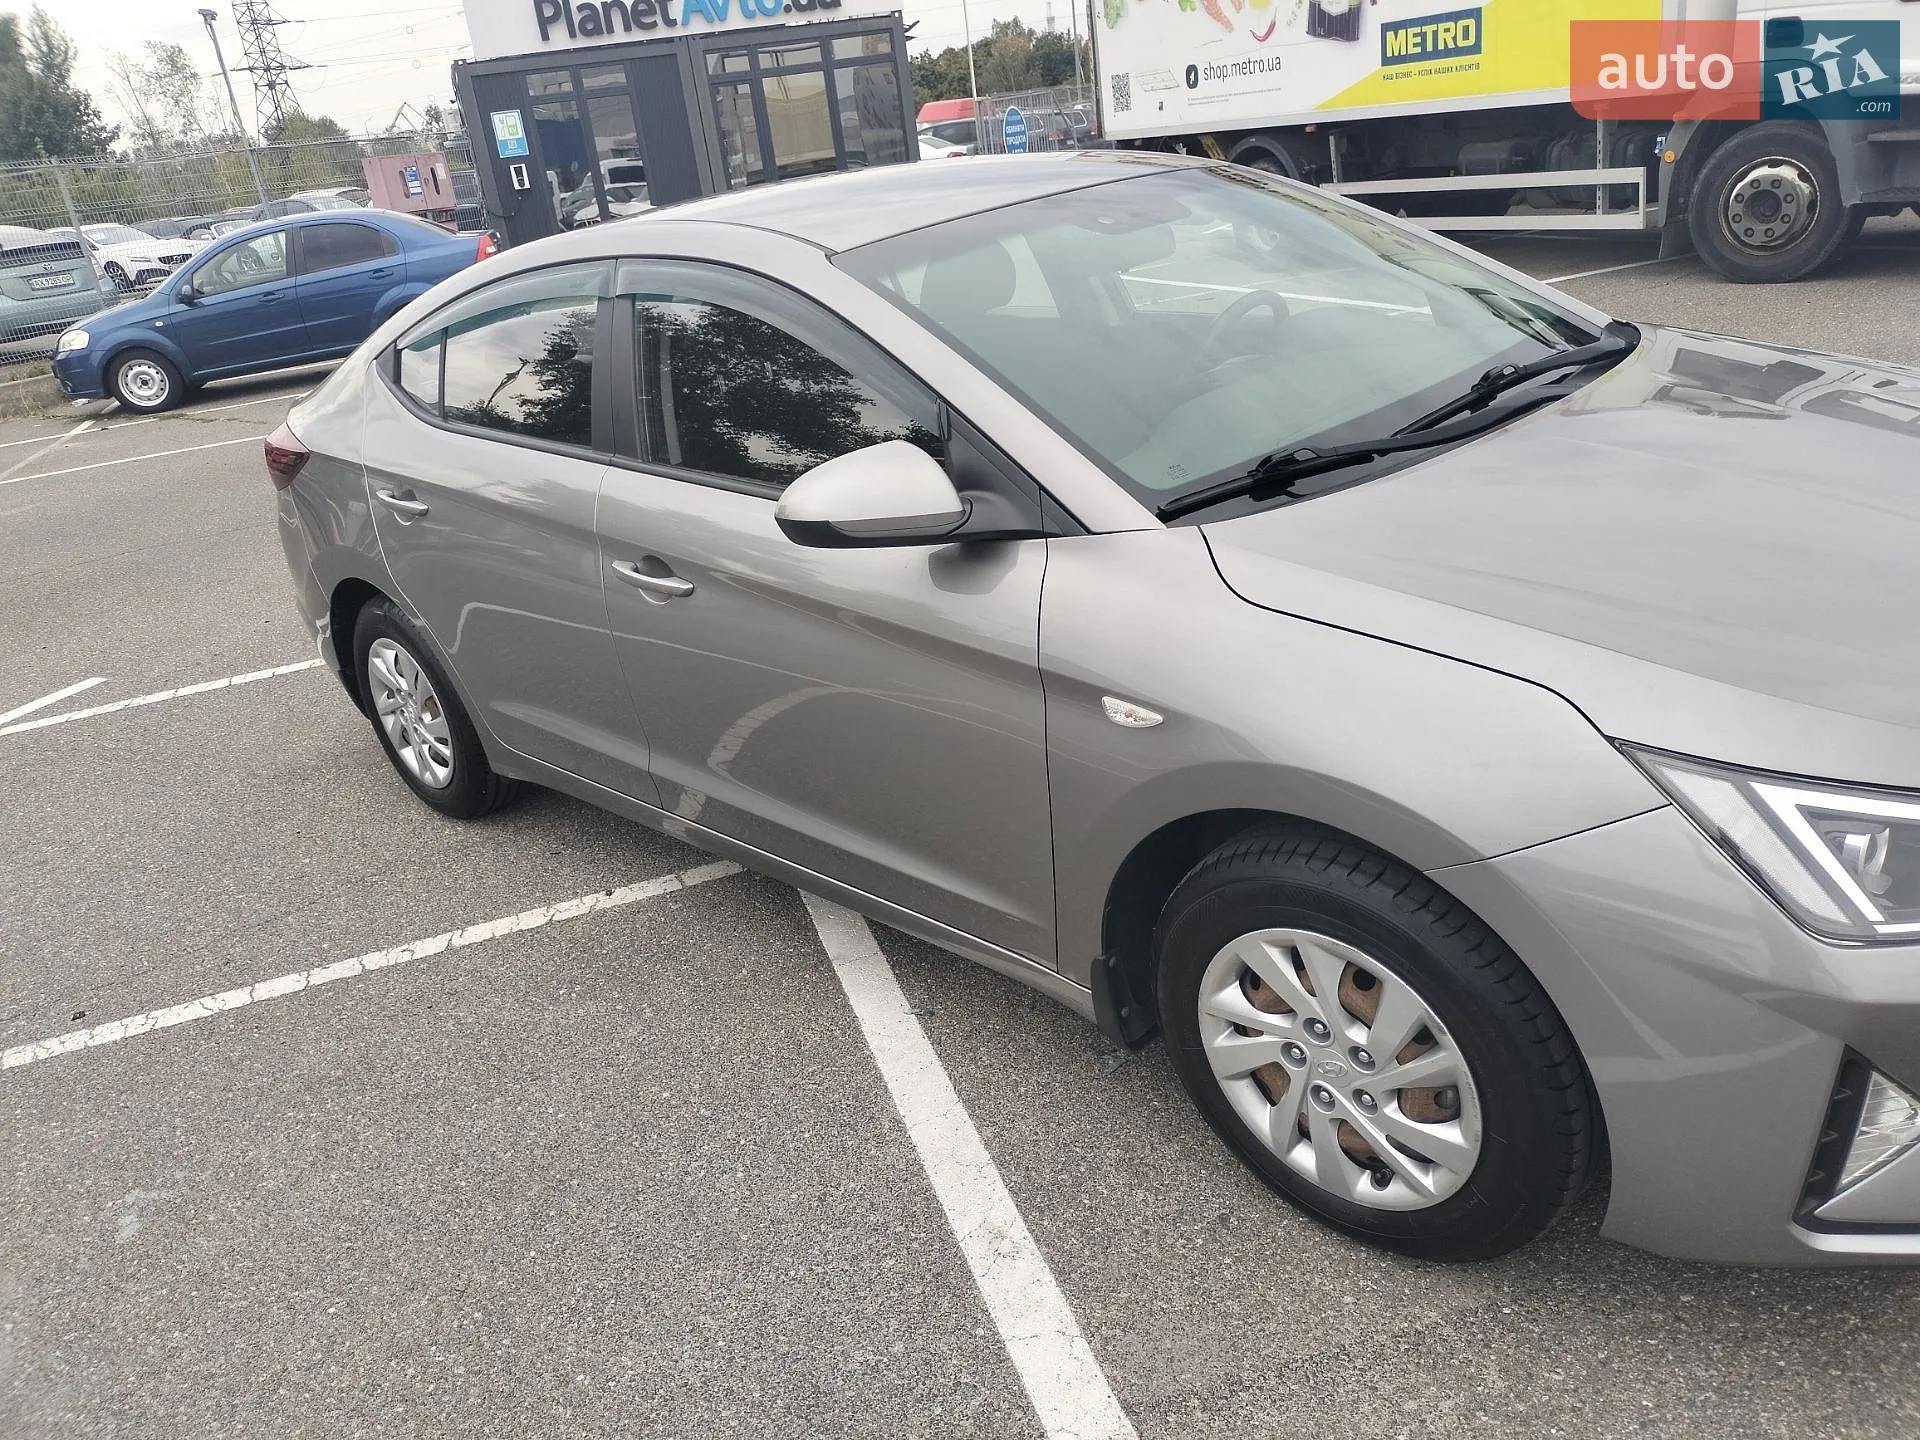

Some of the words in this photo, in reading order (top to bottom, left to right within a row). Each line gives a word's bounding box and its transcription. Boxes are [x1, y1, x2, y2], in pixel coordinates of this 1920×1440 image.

[534, 0, 842, 41] PlanetAvo.
[1386, 18, 1476, 57] METRO
[1203, 56, 1281, 83] shop.metro.ua
[1383, 73, 1394, 81] НАШ
[1395, 71, 1413, 80] БІЗНЕС
[1417, 69, 1432, 77] УСПІХ
[1434, 66, 1454, 75] НАШИХ
